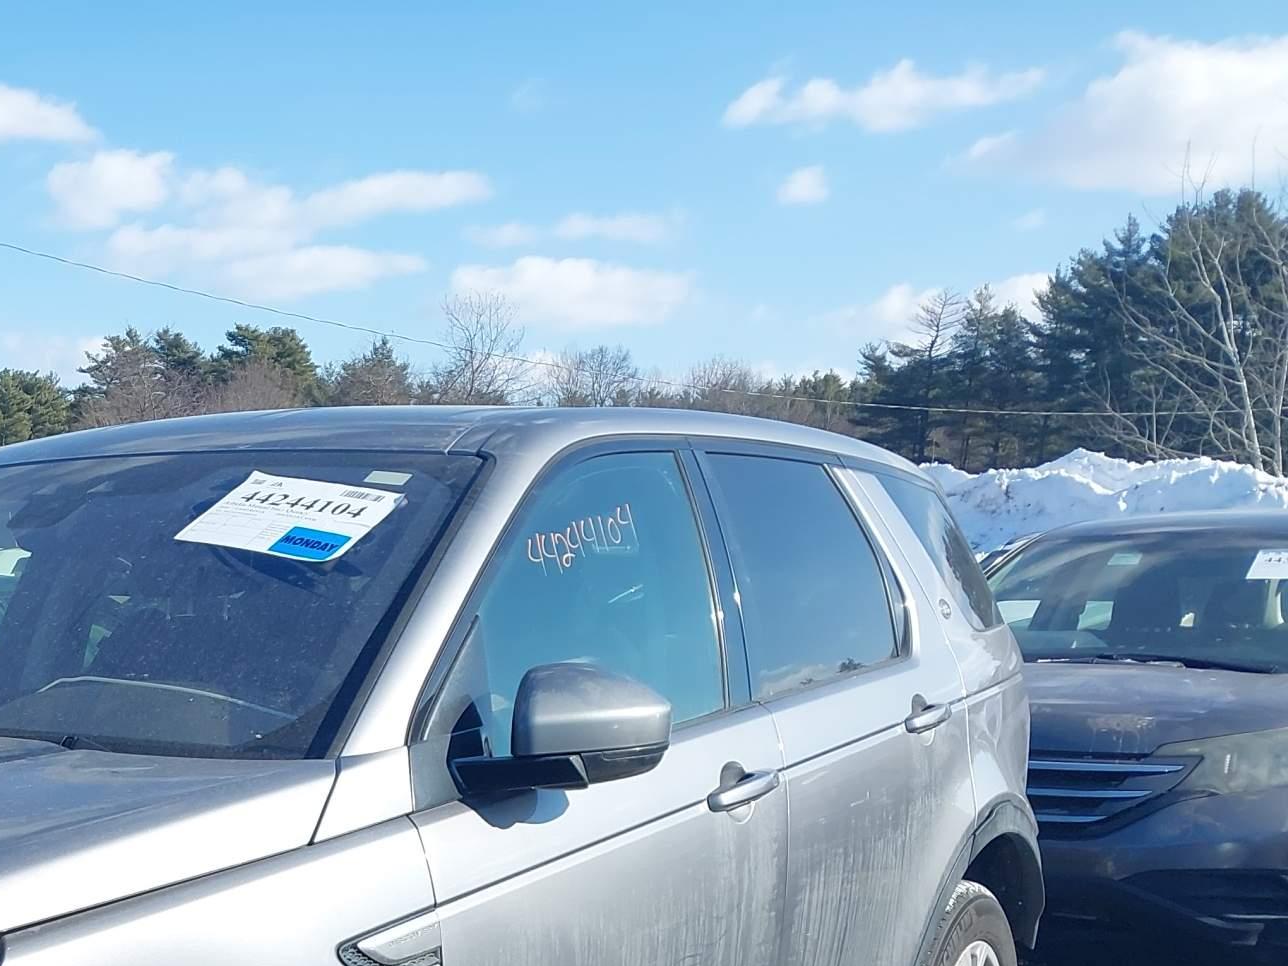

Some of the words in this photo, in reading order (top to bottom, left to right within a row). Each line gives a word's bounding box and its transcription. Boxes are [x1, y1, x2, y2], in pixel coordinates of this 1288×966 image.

[241, 490, 369, 518] 44244104
[280, 535, 340, 553] MONDAY
[527, 503, 640, 577] 44244104
